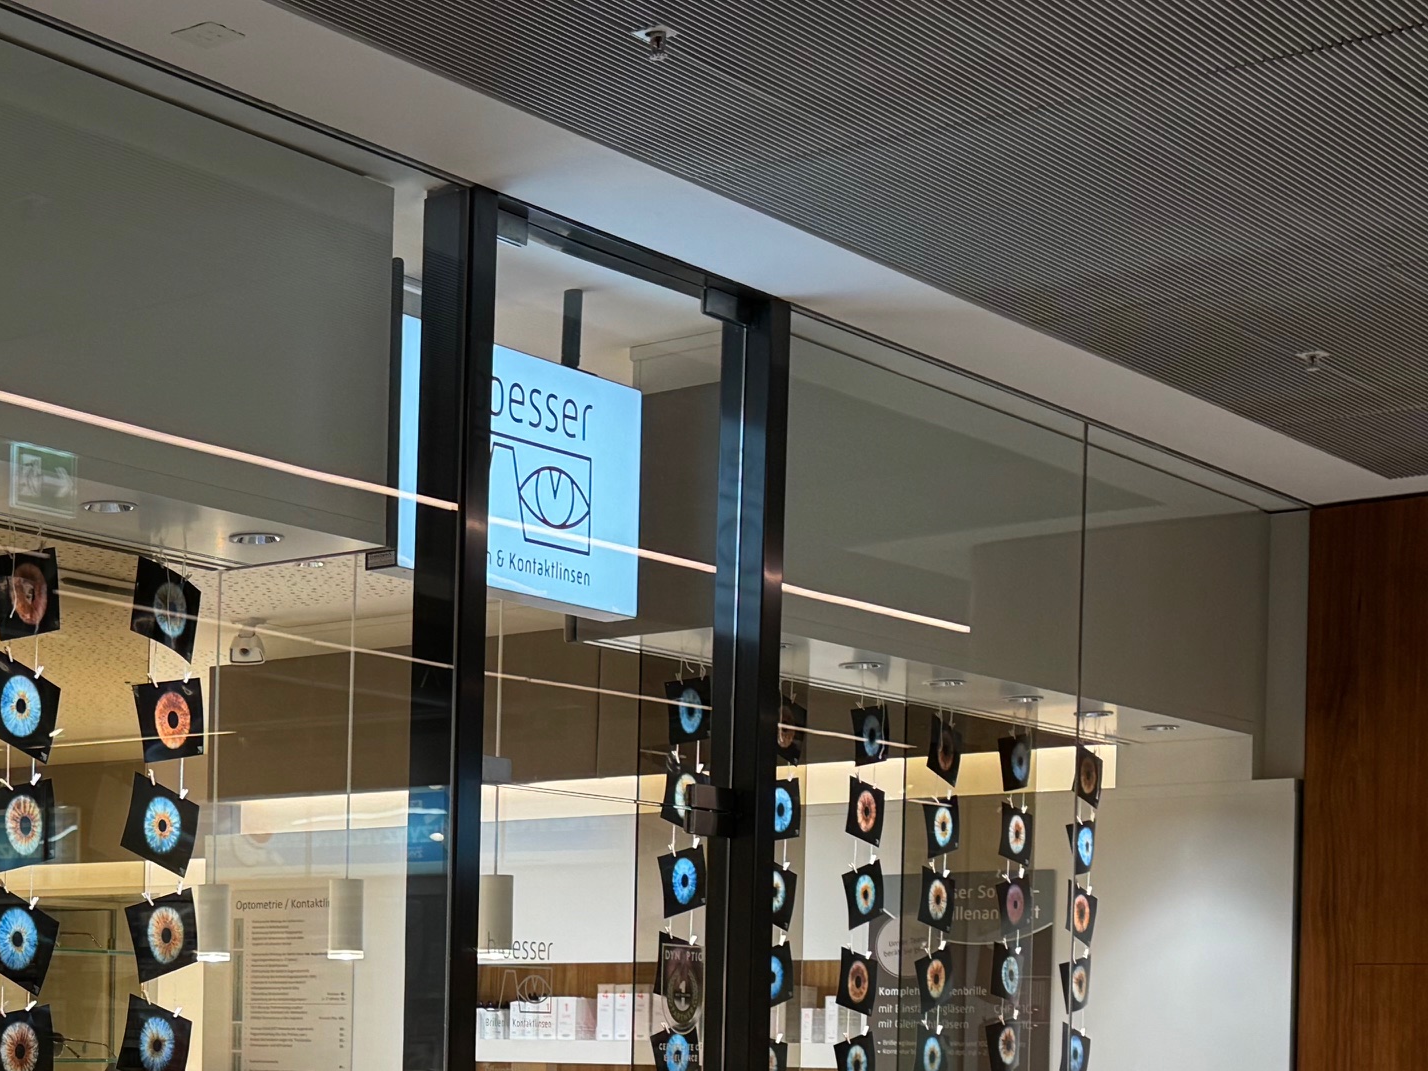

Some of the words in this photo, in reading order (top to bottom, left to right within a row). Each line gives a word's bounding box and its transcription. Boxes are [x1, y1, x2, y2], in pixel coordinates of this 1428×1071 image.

[491, 375, 593, 441] oesser
[497, 549, 505, 568] &
[509, 551, 591, 587] Kontaktlinsen
[235, 899, 283, 912] Optometrie
[284, 898, 289, 911] /
[665, 949, 703, 962] DYNPTIC
[878, 1005, 892, 1014] mit
[877, 1020, 892, 1029] mit
